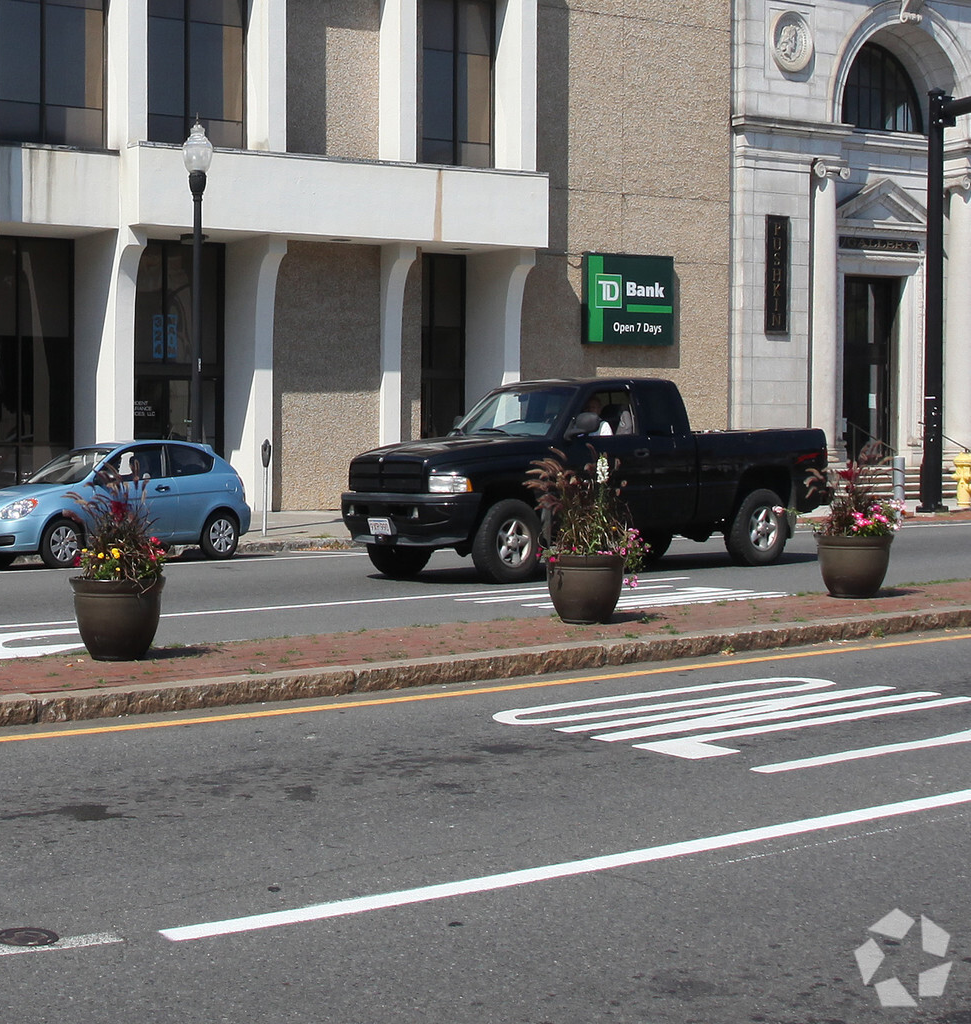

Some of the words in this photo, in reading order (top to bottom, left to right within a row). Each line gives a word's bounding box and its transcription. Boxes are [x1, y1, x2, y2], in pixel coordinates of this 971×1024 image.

[847, 237, 914, 250] GALLERY
[771, 222, 782, 326] PUSHKIN
[597, 280, 620, 302] TD
[626, 281, 665, 298] Bank
[613, 322, 635, 334] Open
[636, 323, 642, 333] 7
[643, 323, 662, 335] Days
